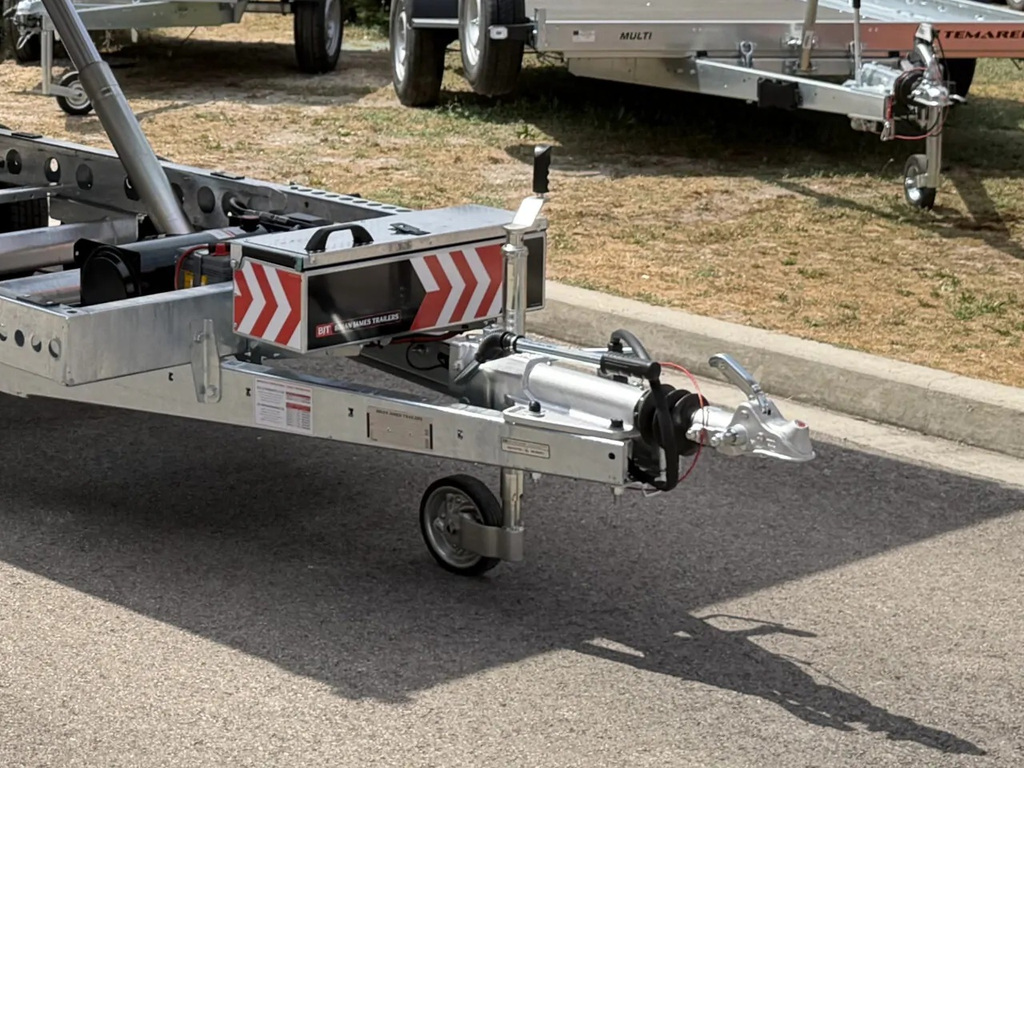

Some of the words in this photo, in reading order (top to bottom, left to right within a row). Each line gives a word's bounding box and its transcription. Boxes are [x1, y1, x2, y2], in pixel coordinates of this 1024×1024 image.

[619, 31, 653, 40] MULTI
[943, 29, 1024, 40] TEMARE
[373, 313, 399, 324] TRAILERS
